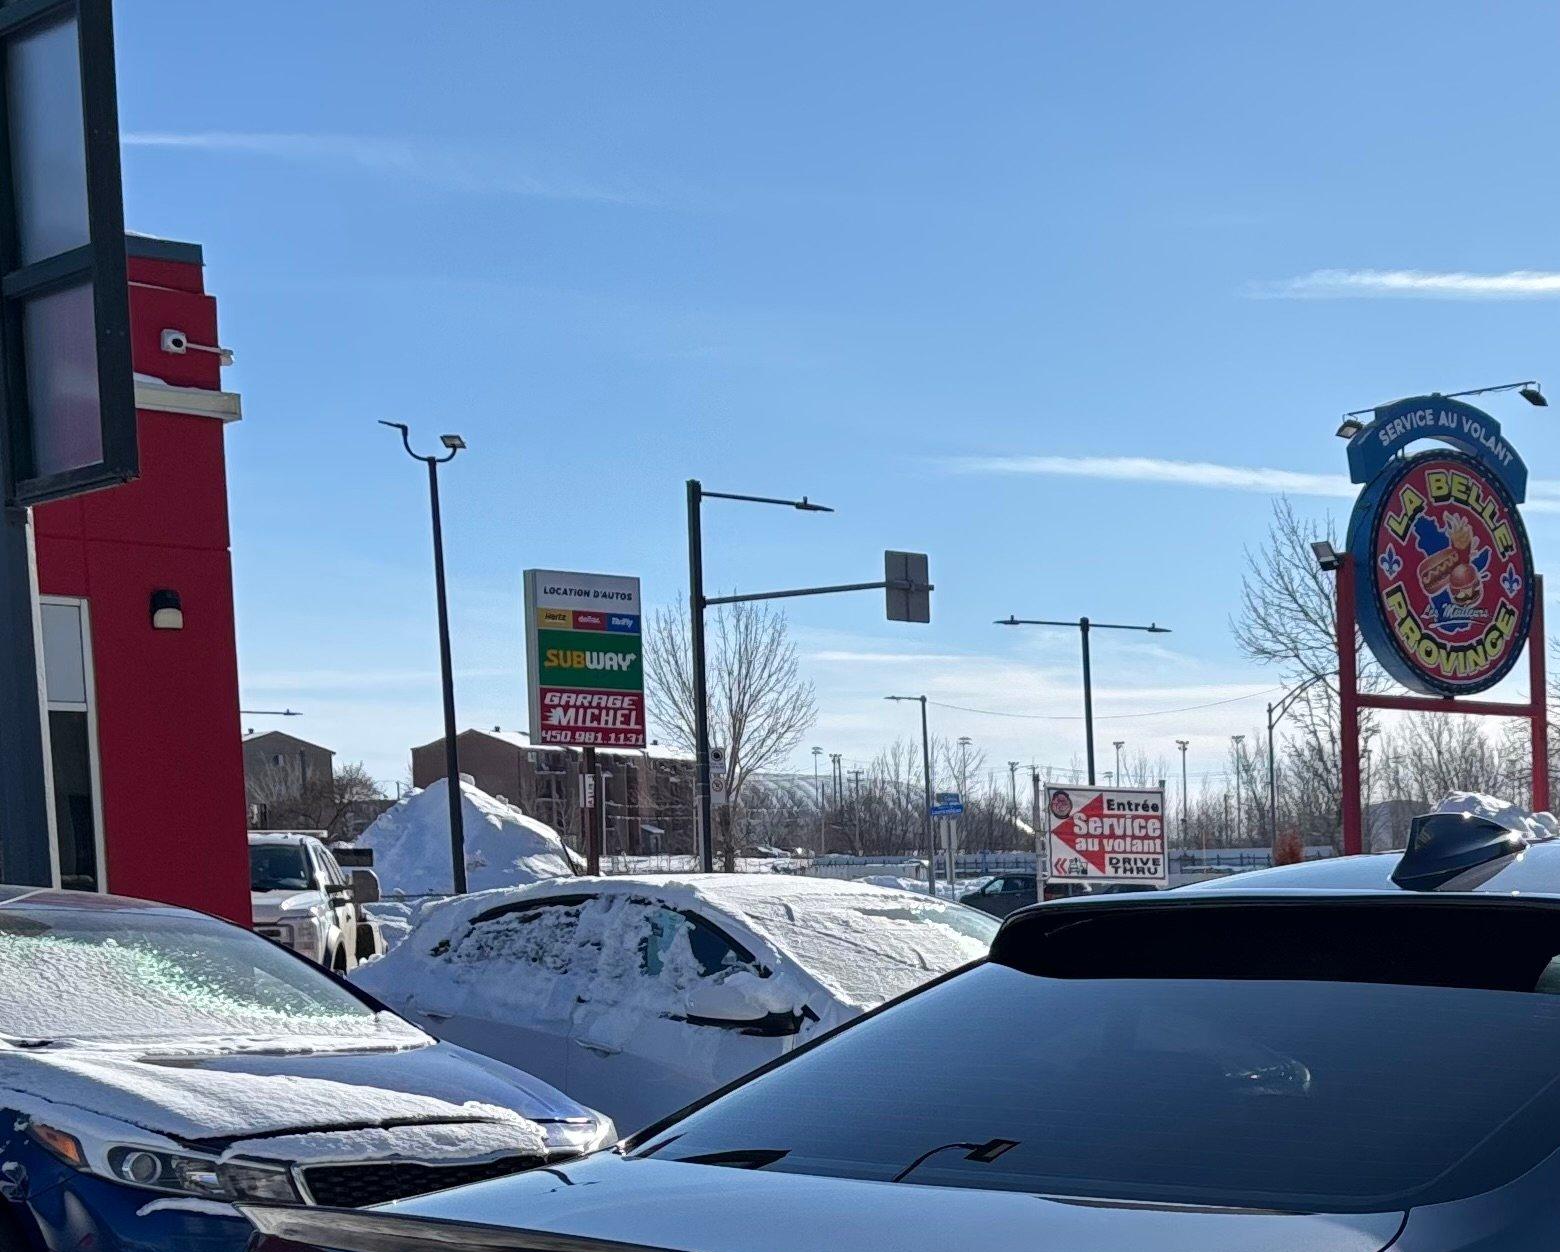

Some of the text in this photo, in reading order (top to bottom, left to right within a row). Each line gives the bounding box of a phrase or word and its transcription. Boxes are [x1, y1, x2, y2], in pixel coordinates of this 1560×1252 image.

[1378, 409, 1513, 466] SERVICE AU VOLANT
[1386, 470, 1516, 560] LA BELLE
[543, 586, 633, 602] LOCATION D'AUTOS
[544, 612, 567, 621] Hertz
[1384, 584, 1516, 675] PROVINCE
[545, 650, 636, 671] SUBWAY
[544, 692, 639, 709] GARAGE
[551, 707, 643, 729] MICHEL
[541, 730, 645, 744] 450.981.1131
[1106, 798, 1160, 812] Entrée
[1073, 813, 1160, 837] Service
[1075, 837, 1162, 852] au volant
[1108, 856, 1161, 867] DRIVE
[1111, 866, 1158, 875] THRU
